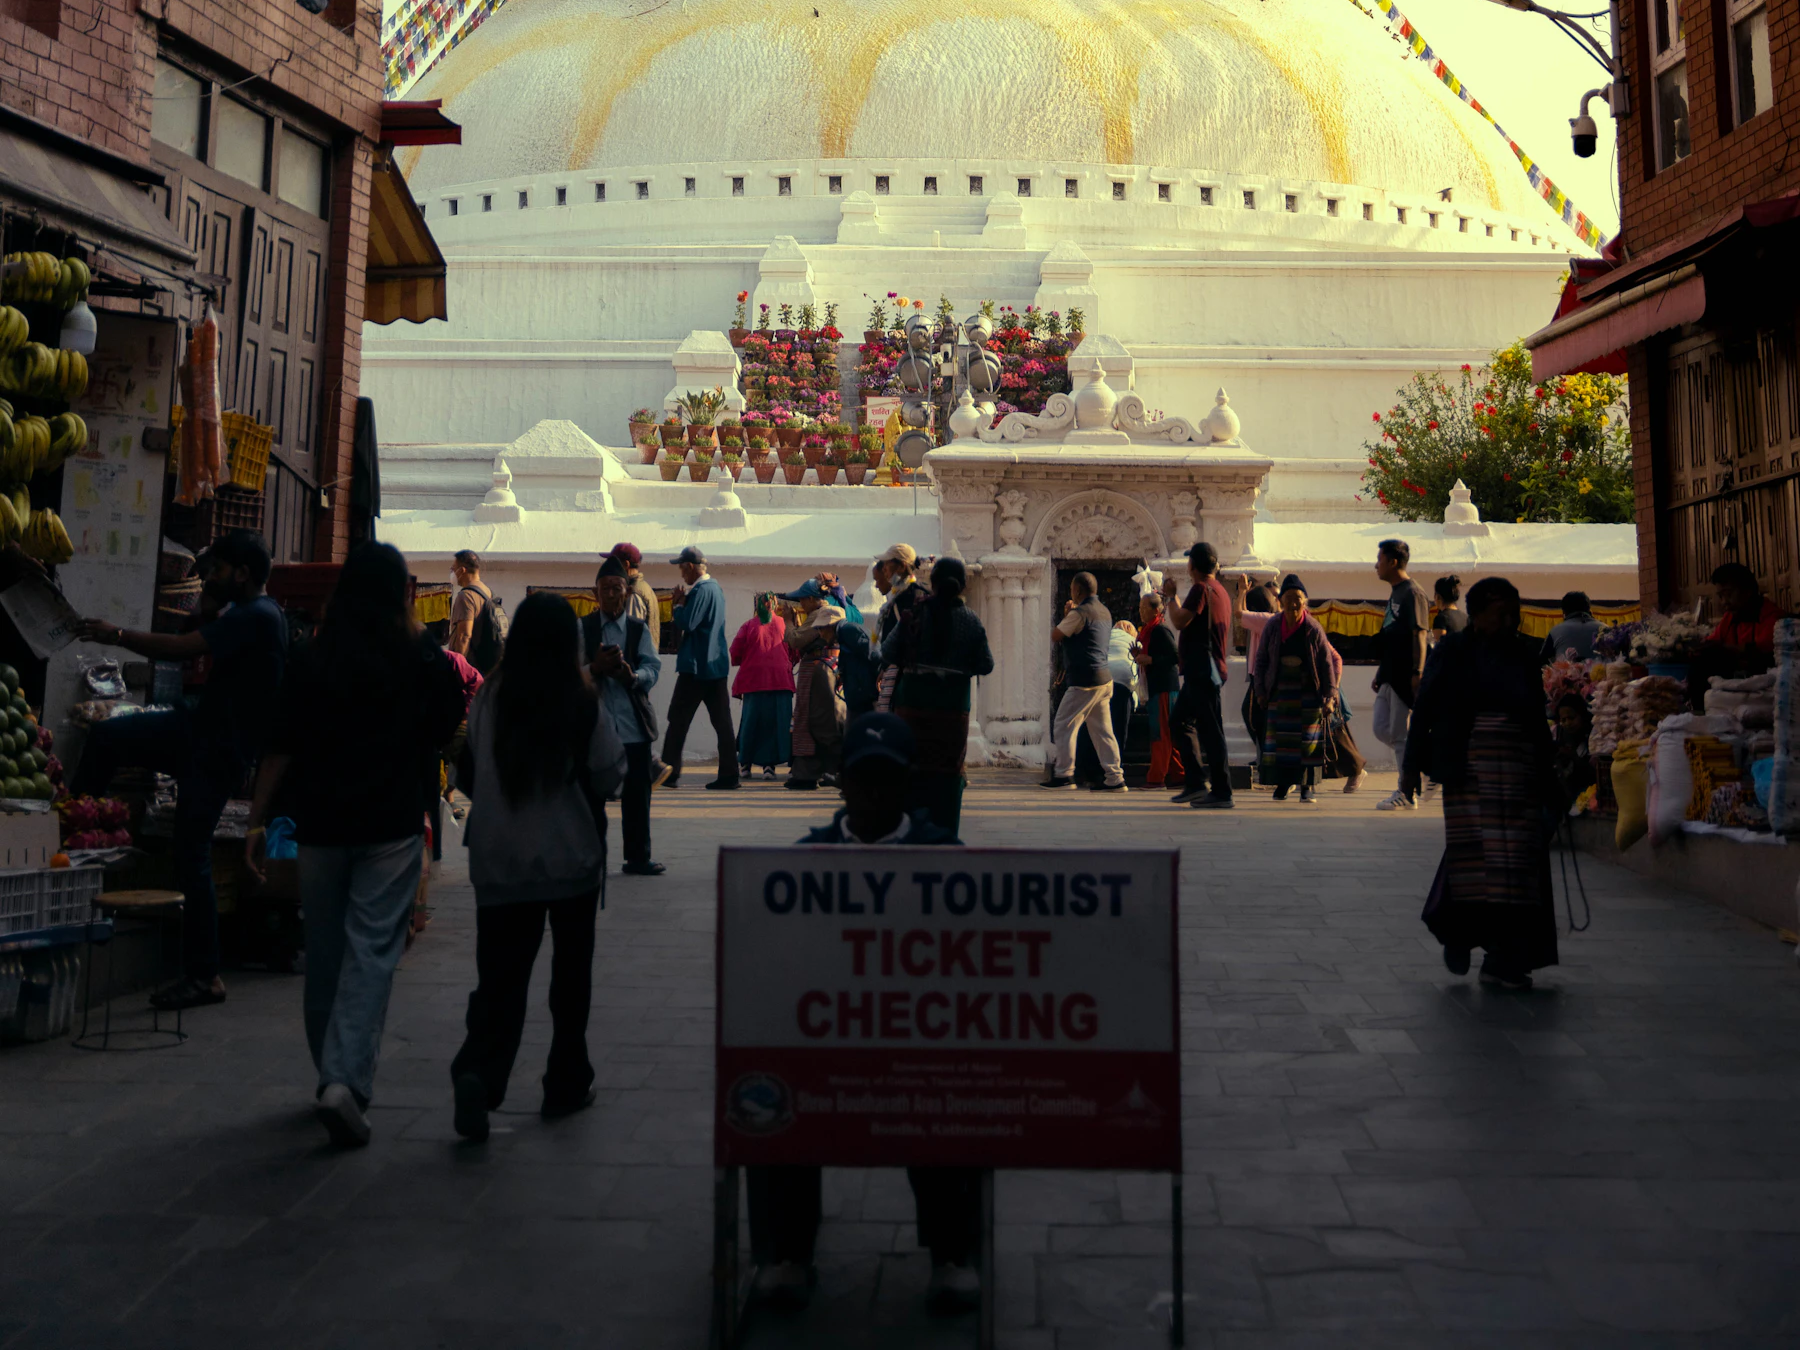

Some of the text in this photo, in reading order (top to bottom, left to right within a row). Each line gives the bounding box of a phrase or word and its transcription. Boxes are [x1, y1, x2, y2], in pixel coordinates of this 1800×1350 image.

[764, 872, 1130, 916] ONLY TOURIST
[843, 930, 1051, 977] TICKET
[797, 991, 1097, 1041] CHECKING
[797, 1090, 1098, 1118] Shree Boudhanath Area Development Committee
